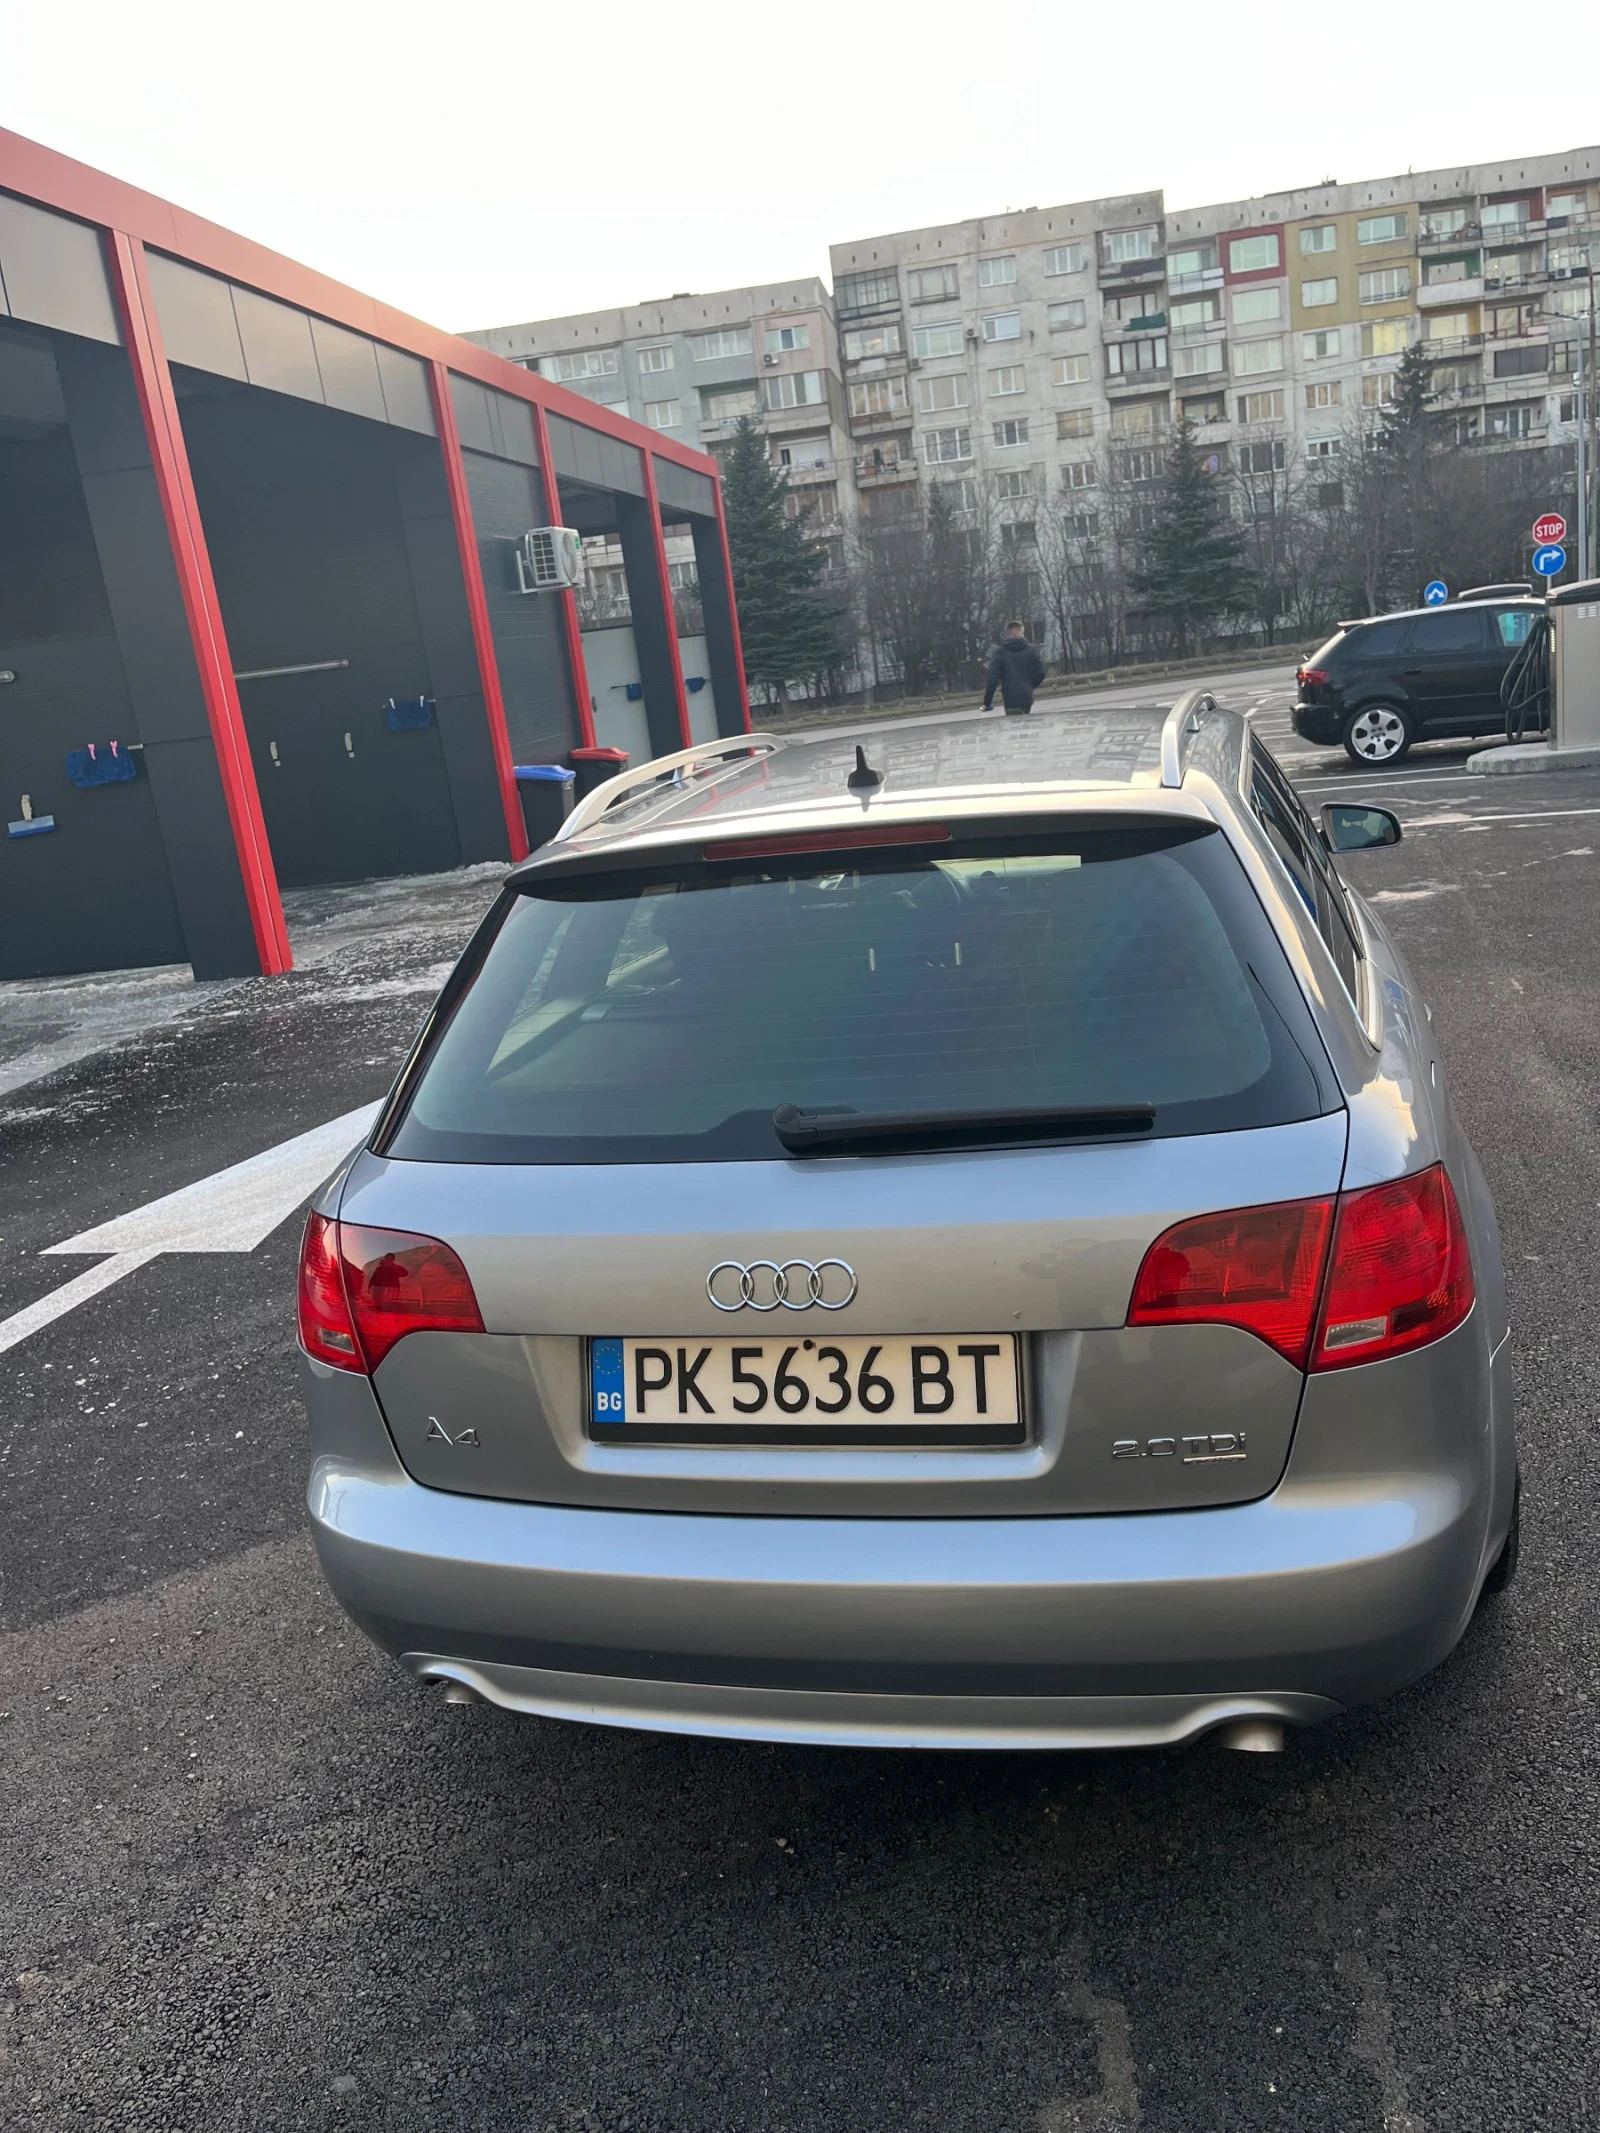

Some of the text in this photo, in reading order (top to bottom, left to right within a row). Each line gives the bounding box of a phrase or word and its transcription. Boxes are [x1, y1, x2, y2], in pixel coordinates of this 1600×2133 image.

[1536, 523, 1563, 538] STOP
[634, 1345, 1001, 1414] PK 5636 BT
[597, 1391, 622, 1411] BG
[426, 1416, 480, 1447] A4
[1112, 1437, 1175, 1458] 2.0
